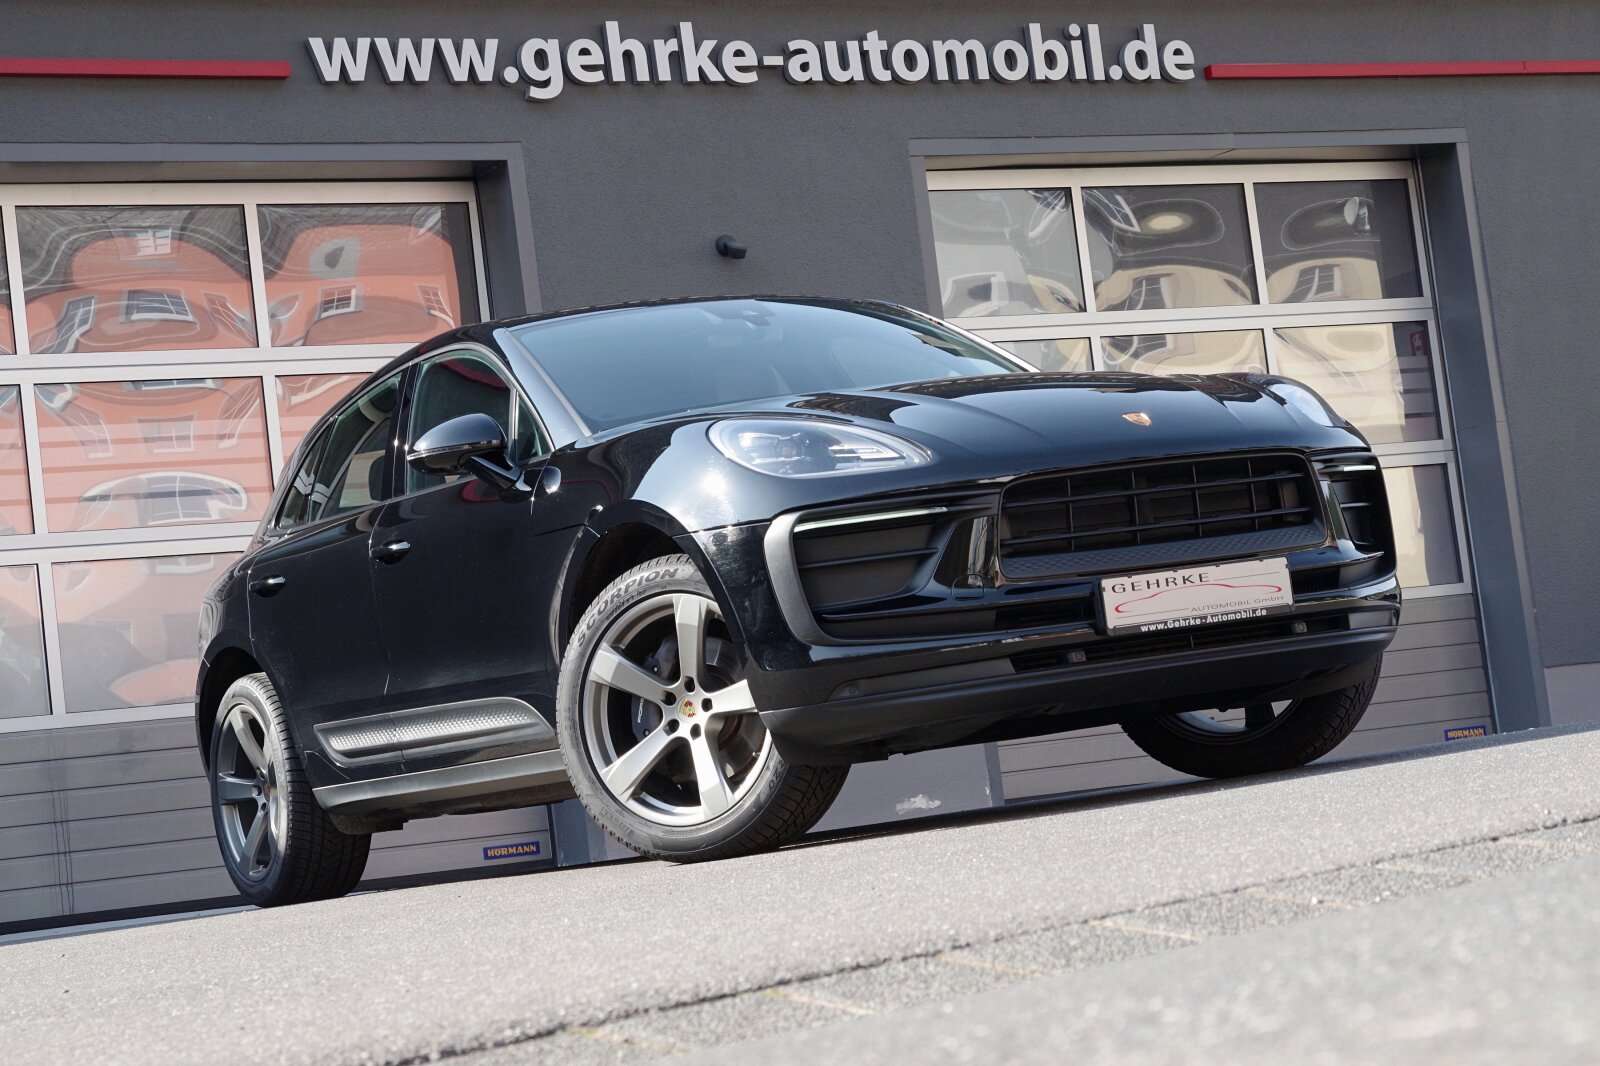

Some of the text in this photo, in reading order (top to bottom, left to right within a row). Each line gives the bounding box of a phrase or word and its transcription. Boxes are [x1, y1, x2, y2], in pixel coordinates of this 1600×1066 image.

[307, 20, 1196, 101] www.gehrke-automobil.de
[577, 567, 679, 647] SCORPION
[1111, 572, 1210, 594] GEHRKE
